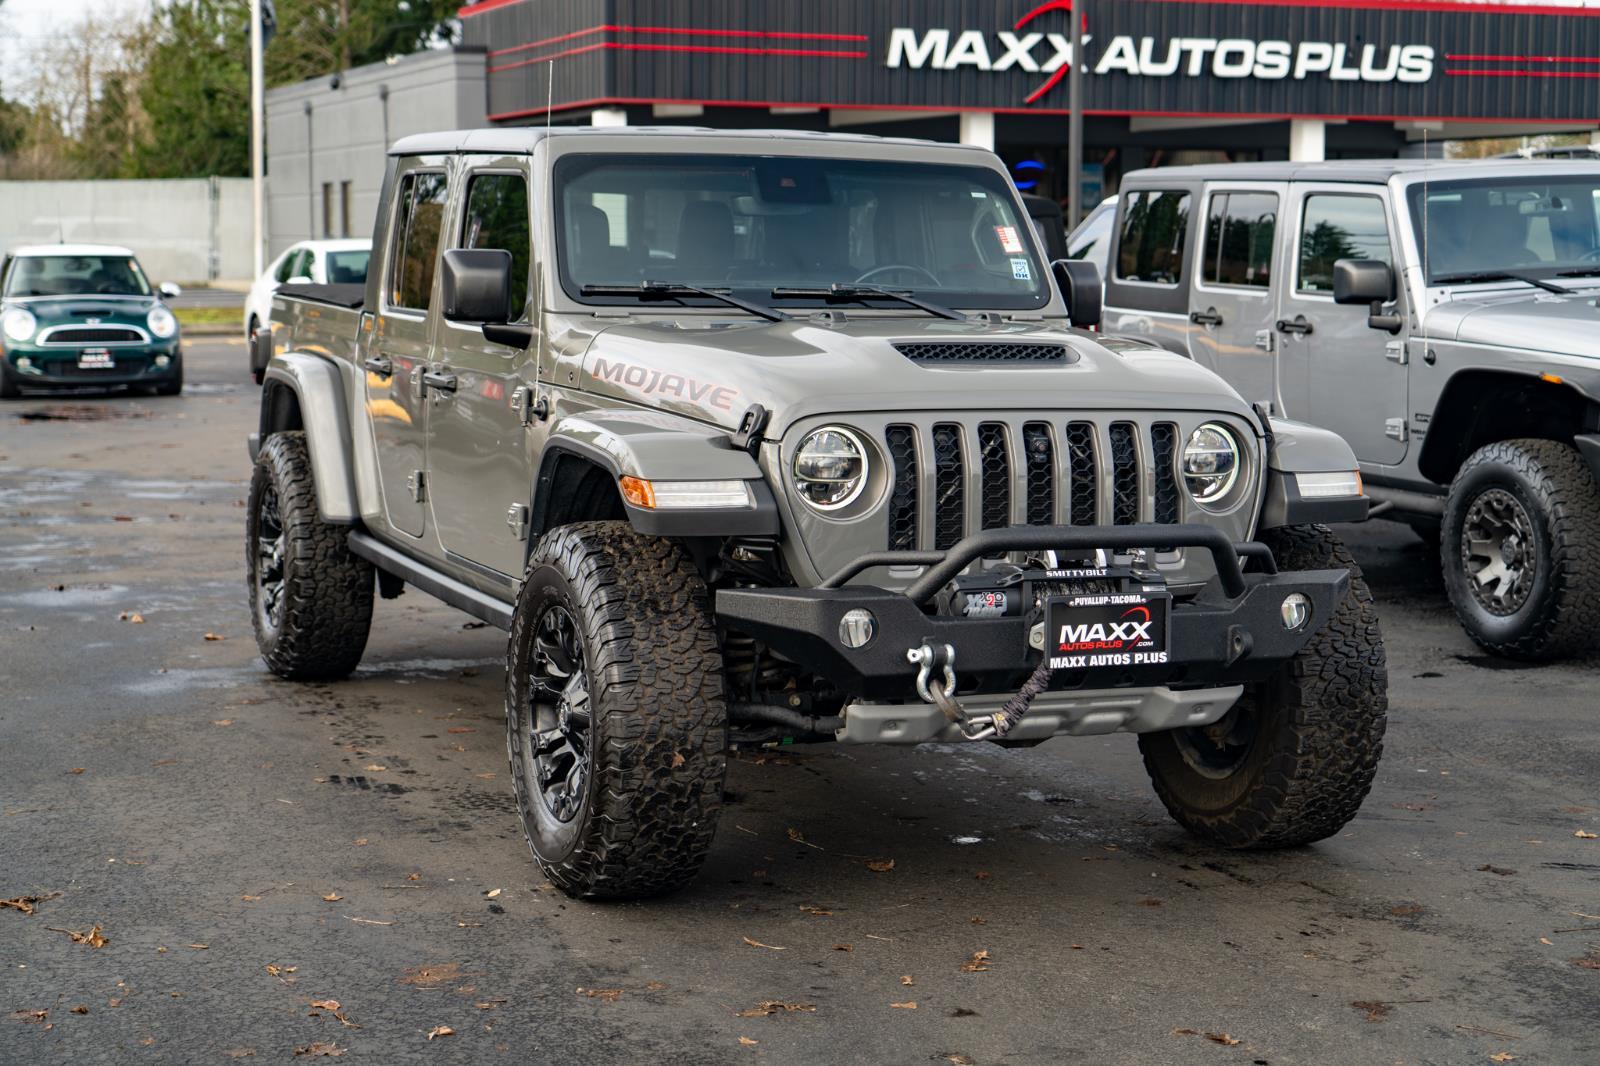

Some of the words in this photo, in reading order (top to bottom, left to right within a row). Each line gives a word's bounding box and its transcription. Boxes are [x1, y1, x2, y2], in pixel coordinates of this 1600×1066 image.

[887, 27, 1093, 74] MAXX
[592, 357, 740, 412] MOJAVE
[1046, 569, 1107, 577] SMITTYBILT
[1059, 621, 1152, 644] MAXX
[1050, 656, 1086, 669] MAXX
[1089, 654, 1131, 666] AUTOS
[1134, 652, 1168, 664] PLUS
